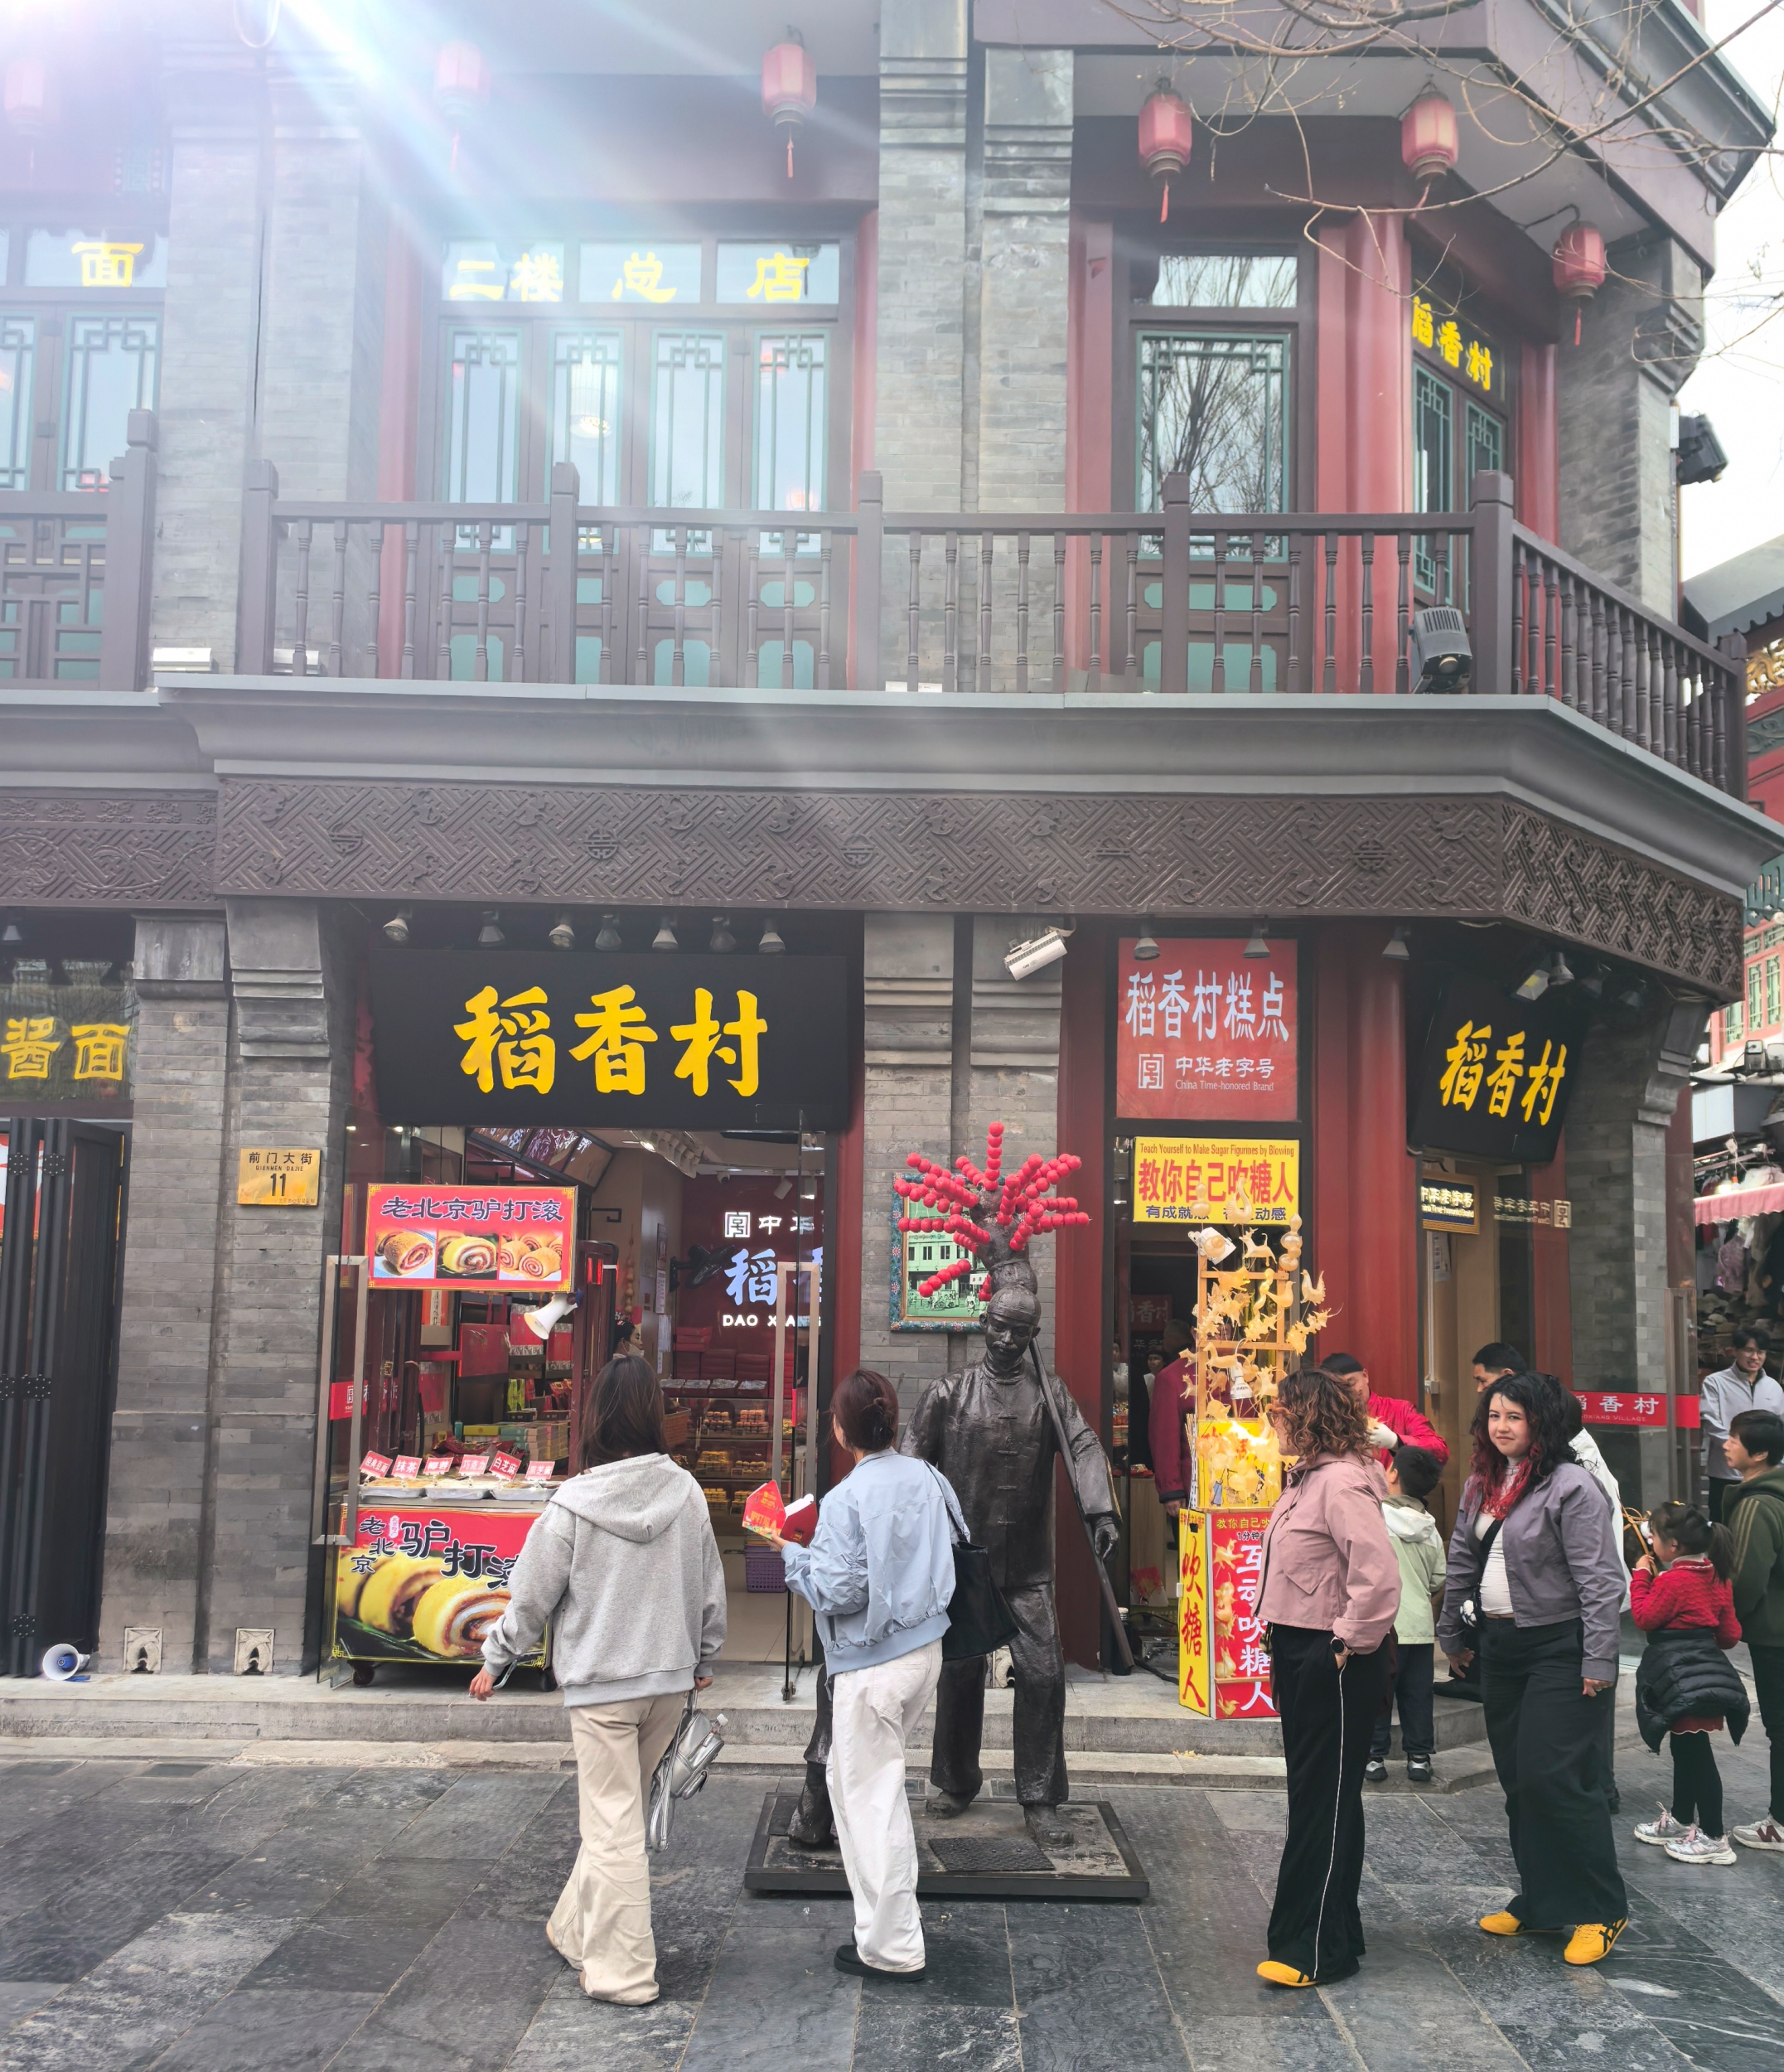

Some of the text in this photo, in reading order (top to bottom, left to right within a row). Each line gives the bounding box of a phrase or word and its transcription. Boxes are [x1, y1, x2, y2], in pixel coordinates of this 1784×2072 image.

[71, 242, 144, 288] 面
[449, 252, 810, 303] 二楼总店
[1411, 295, 1493, 391] 稻香村
[1125, 969, 1289, 1042] 稻香村糕点
[1, 1016, 131, 1081] 酱面
[453, 985, 769, 1097] 稻香村
[1175, 1056, 1275, 1079] 中华老字号
[1439, 1019, 1567, 1126] 稻香村
[1175, 1079, 1274, 1092] China Time-honored Brand
[249, 1152, 312, 1164] 前门大街
[1140, 1143, 1294, 1158] Teach Yourself to Make Sugar Figurines by Blowing
[270, 1173, 287, 1196] 11
[1139, 1159, 1294, 1204] 教你自己吹糖人
[381, 1197, 564, 1222] 老北京驴打滚
[723, 1314, 758, 1327] DAO
[395, 1460, 417, 1473] 抹茶
[462, 1459, 485, 1470] 巧克力
[493, 1457, 516, 1474] 白芝麻
[350, 1515, 397, 1575] 老北京
[1182, 1536, 1206, 1709] 吹糖人
